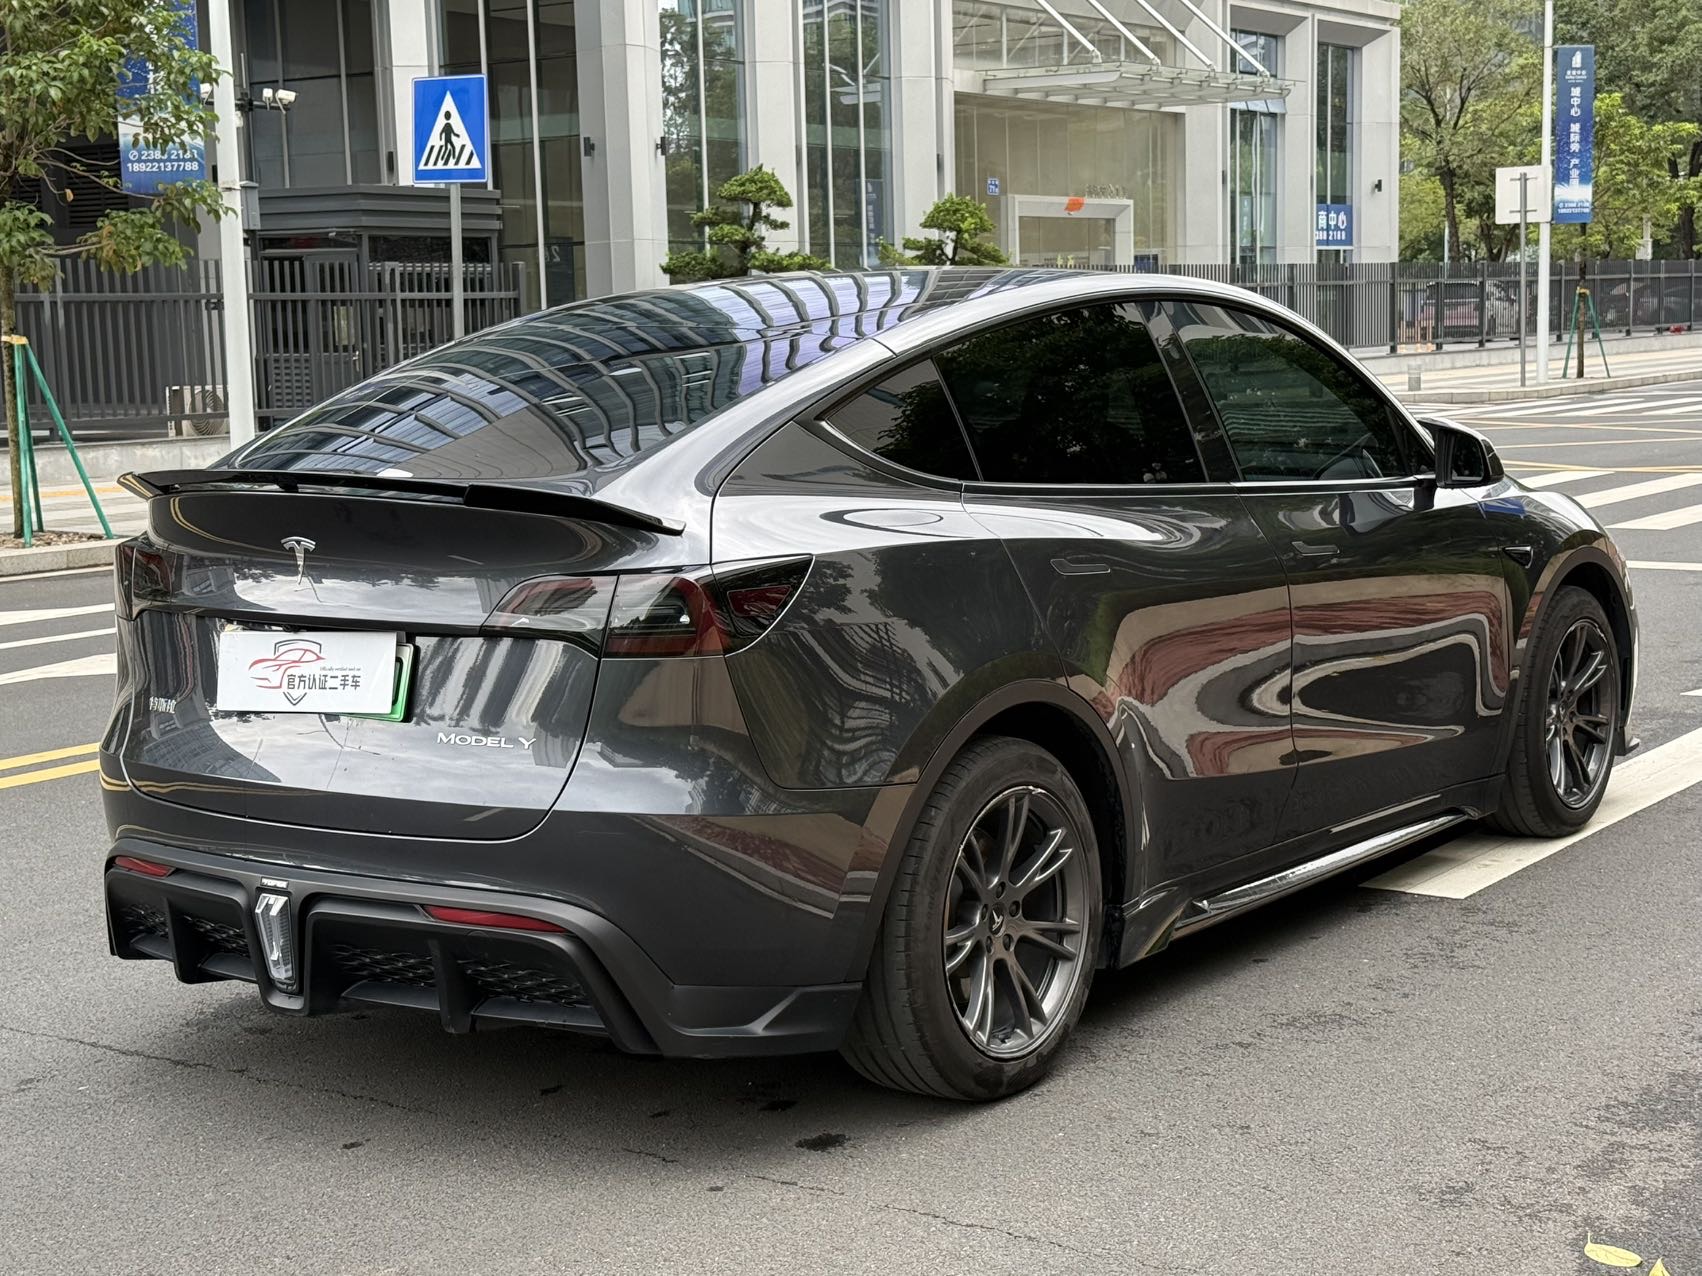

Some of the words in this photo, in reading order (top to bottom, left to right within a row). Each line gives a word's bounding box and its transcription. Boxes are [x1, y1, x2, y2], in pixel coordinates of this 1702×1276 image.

[127, 162, 199, 172] 18922137788
[286, 673, 361, 691] 官方认证二手车
[437, 732, 514, 748] MODEL
[518, 737, 537, 750] Y
